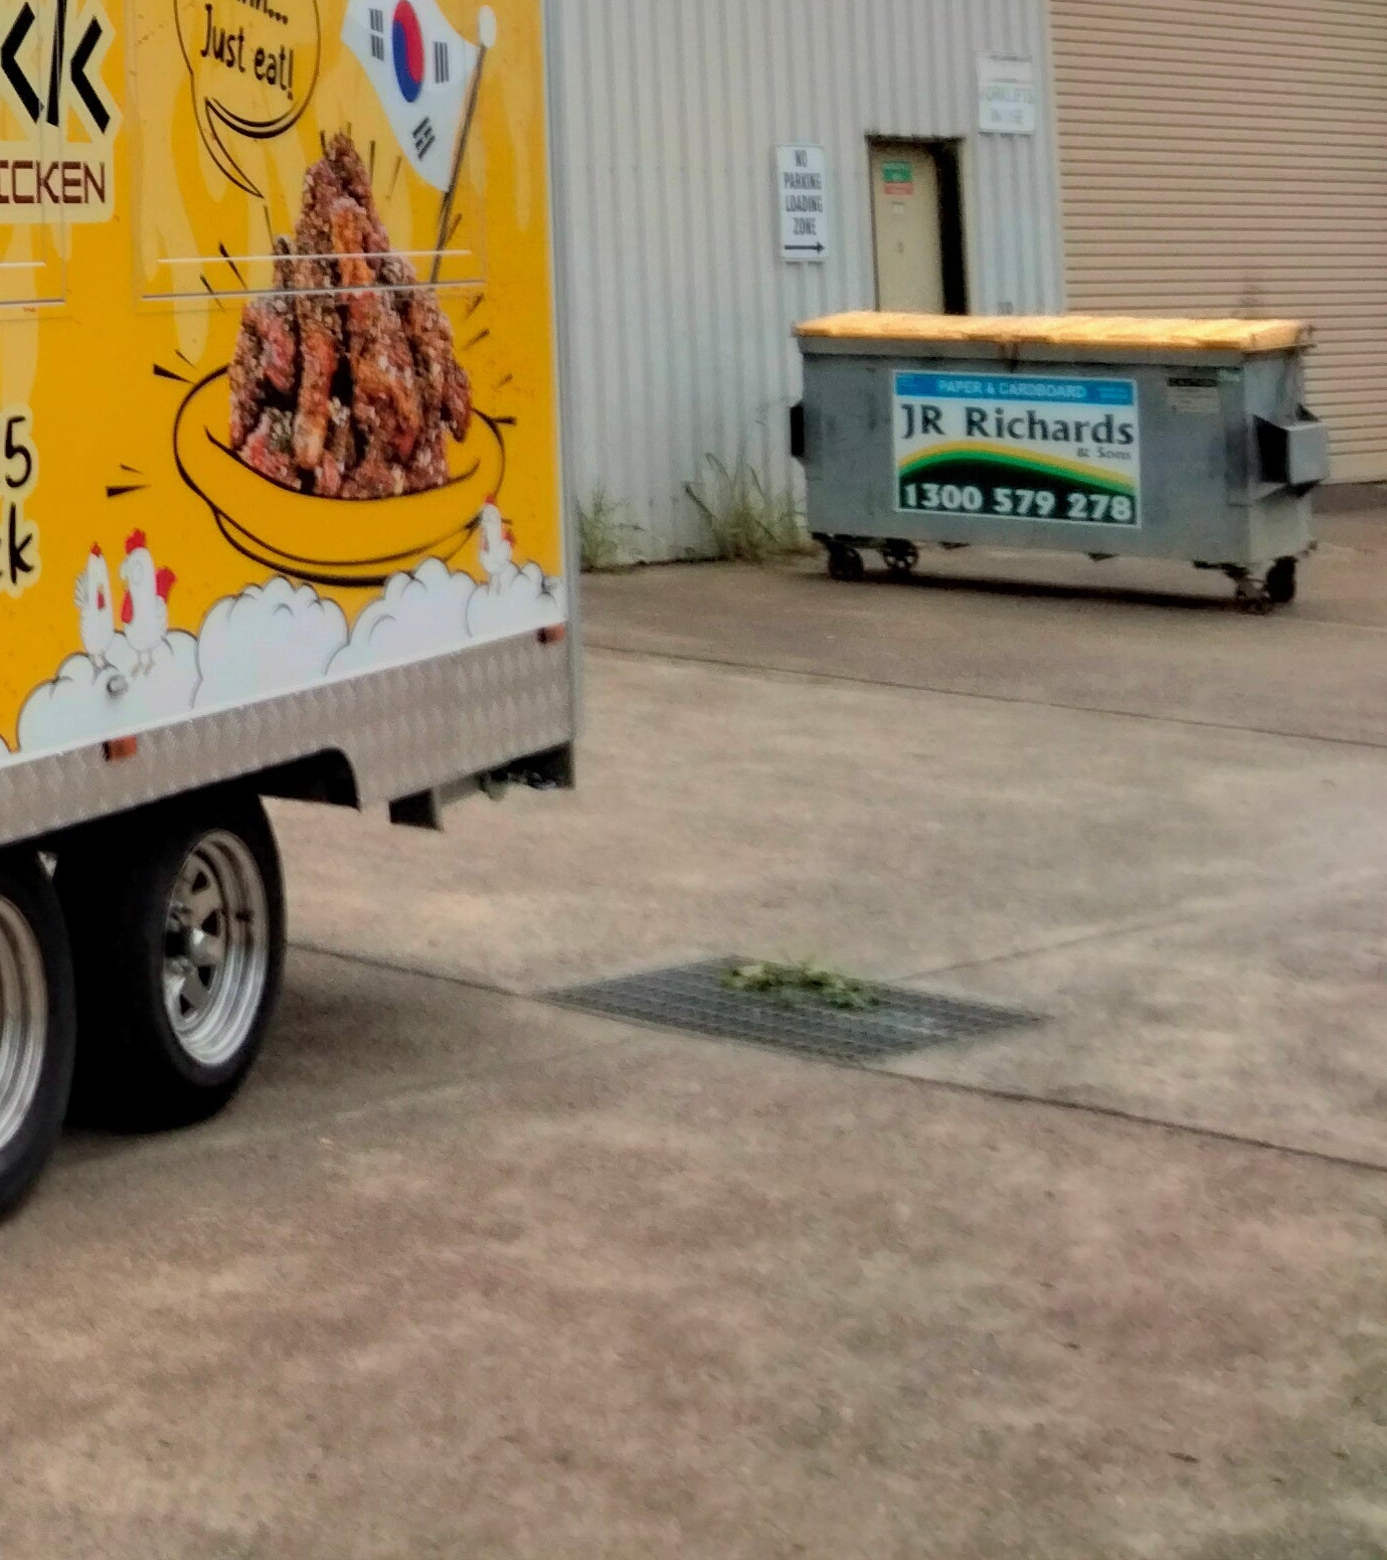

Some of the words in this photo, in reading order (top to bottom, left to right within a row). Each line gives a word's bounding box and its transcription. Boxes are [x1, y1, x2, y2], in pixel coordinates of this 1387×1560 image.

[200, 3, 245, 74] Just
[254, 43, 294, 101] eat!
[794, 148, 808, 168] NO
[783, 171, 822, 190] PARKING
[785, 194, 824, 214] LOADING
[793, 216, 818, 237] ZONE
[937, 378, 983, 396] PAPER
[999, 381, 1088, 400] CARDBOARD
[901, 403, 946, 440] JR
[964, 406, 1134, 446] Richards
[1096, 446, 1132, 460] Sons
[905, 483, 983, 511] 1300
[993, 487, 1057, 516] 579
[1067, 492, 1133, 521] 278
